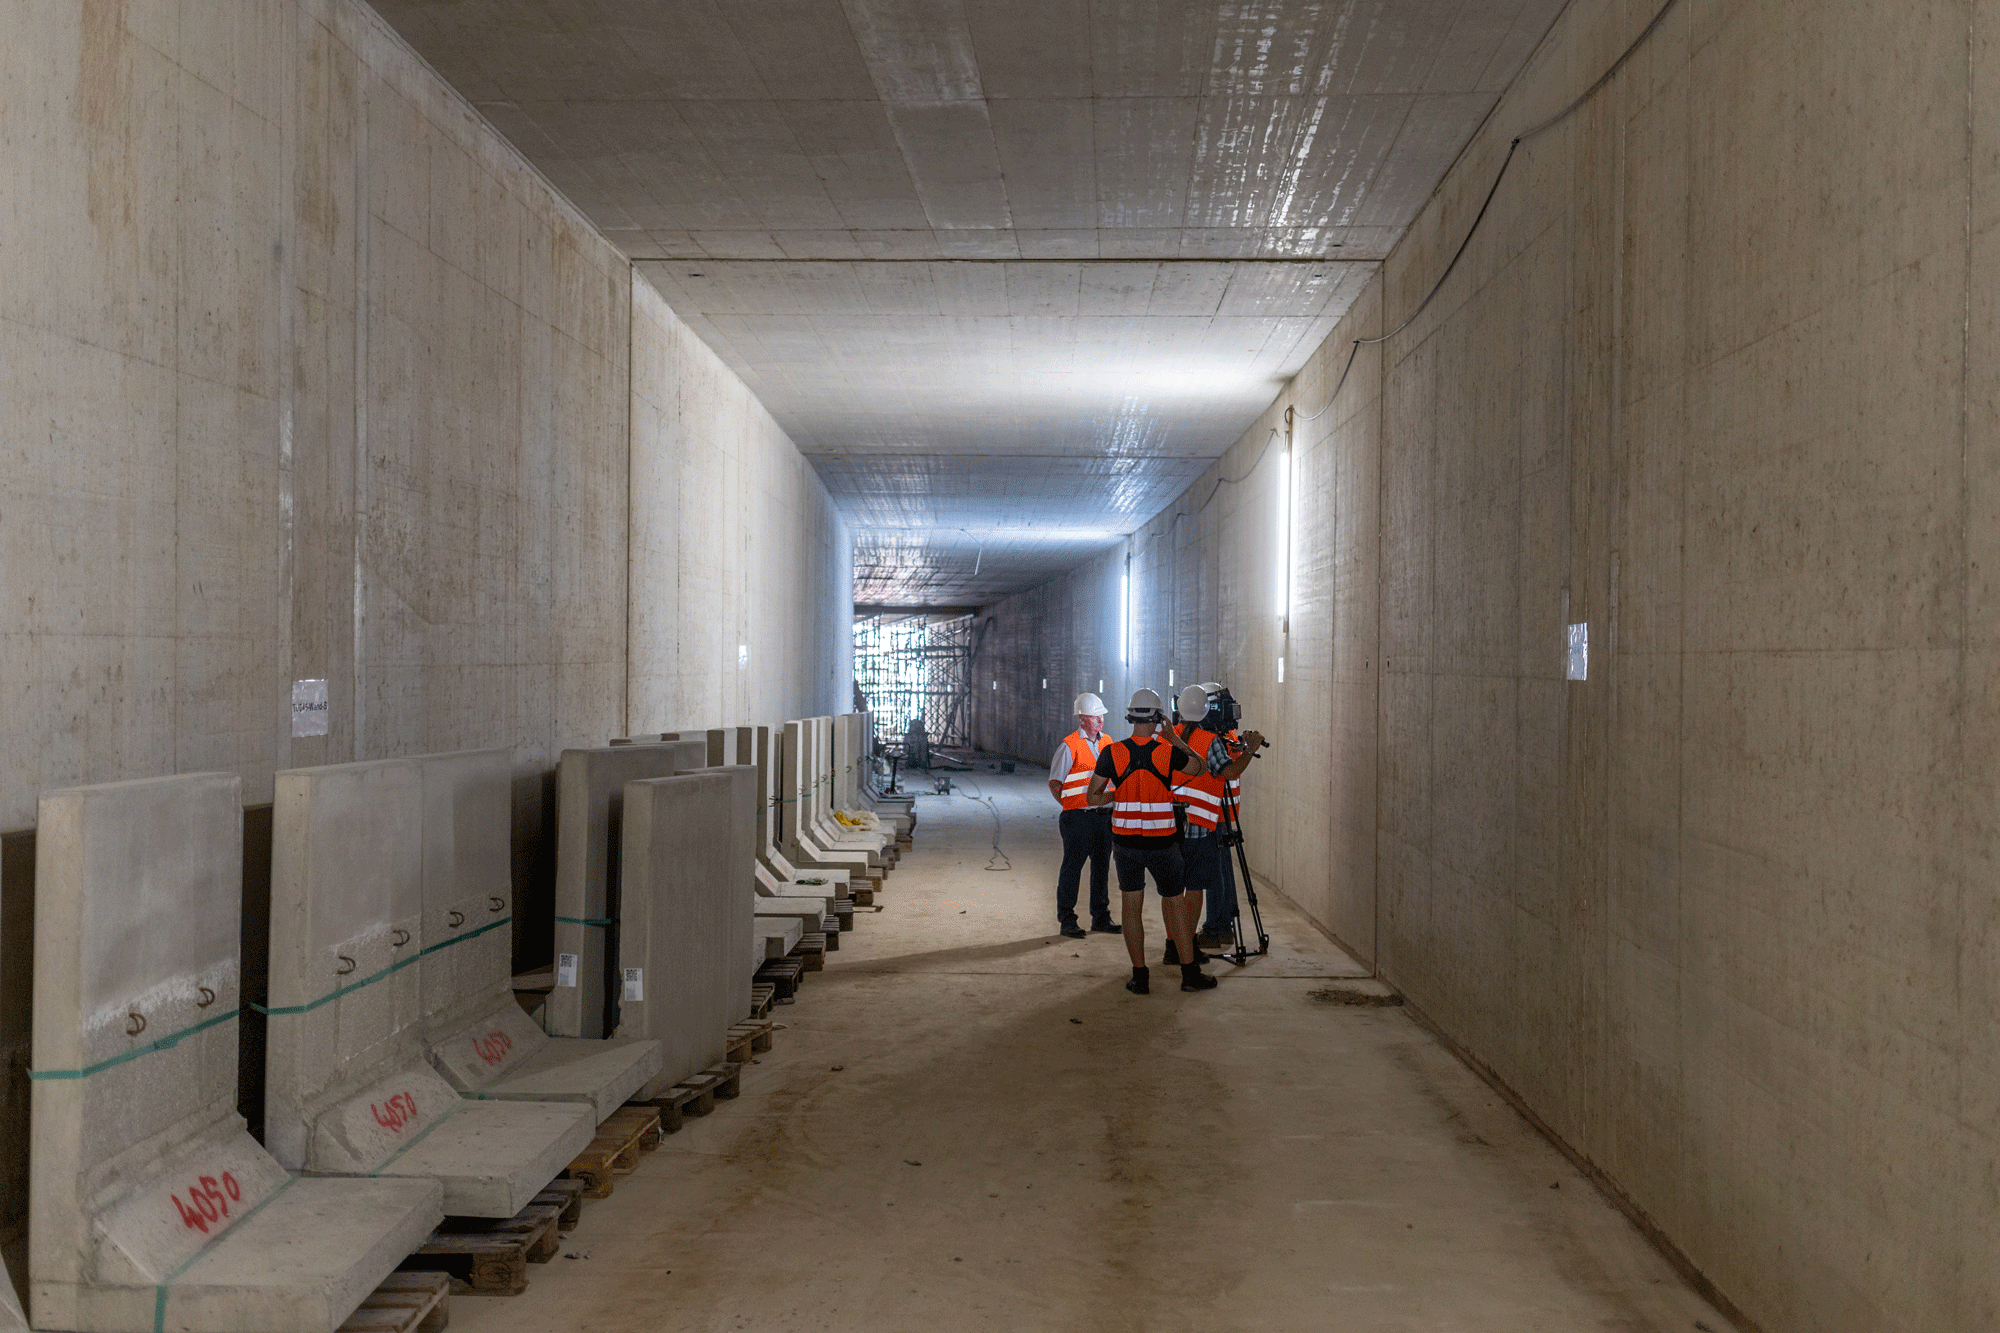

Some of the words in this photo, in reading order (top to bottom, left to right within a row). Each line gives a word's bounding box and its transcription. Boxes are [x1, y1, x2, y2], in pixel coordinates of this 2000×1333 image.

[472, 1031, 512, 1067] 4050
[370, 1091, 417, 1133] 4050
[171, 1171, 239, 1233] 4050
